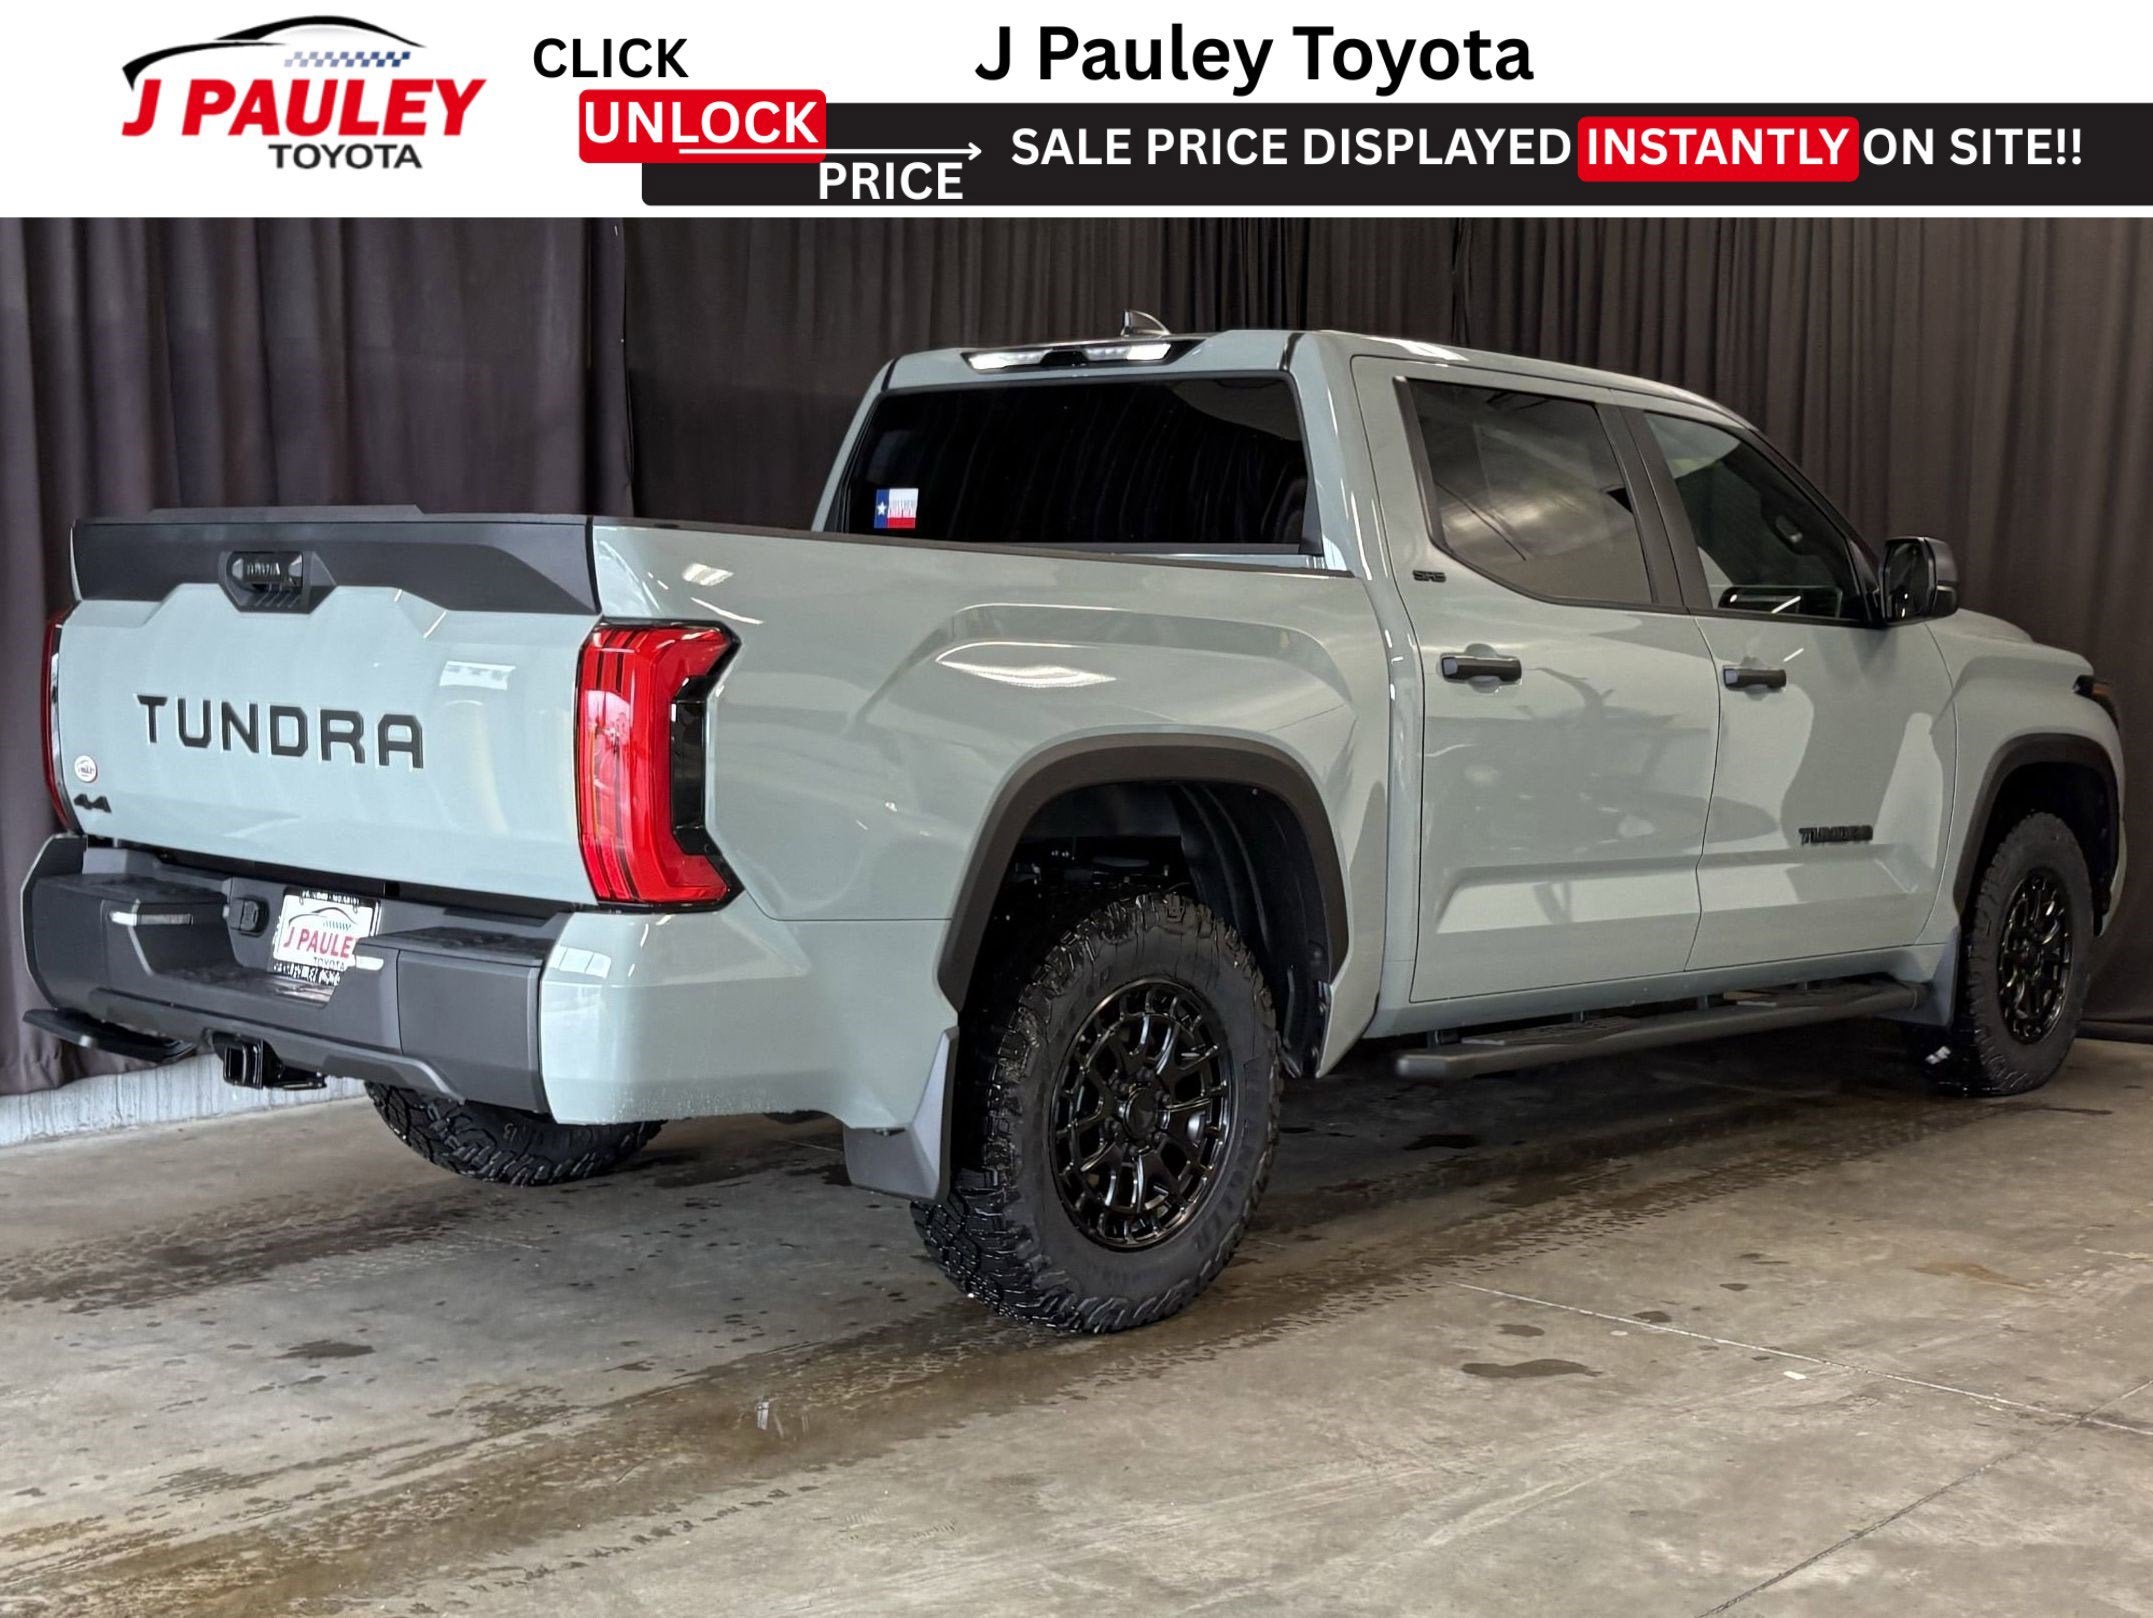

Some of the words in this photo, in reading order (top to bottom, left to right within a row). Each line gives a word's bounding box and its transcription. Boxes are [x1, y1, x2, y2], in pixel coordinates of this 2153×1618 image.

[137, 695, 424, 769] TUNDRA
[284, 926, 296, 948] J
[296, 928, 357, 959] PAULE
